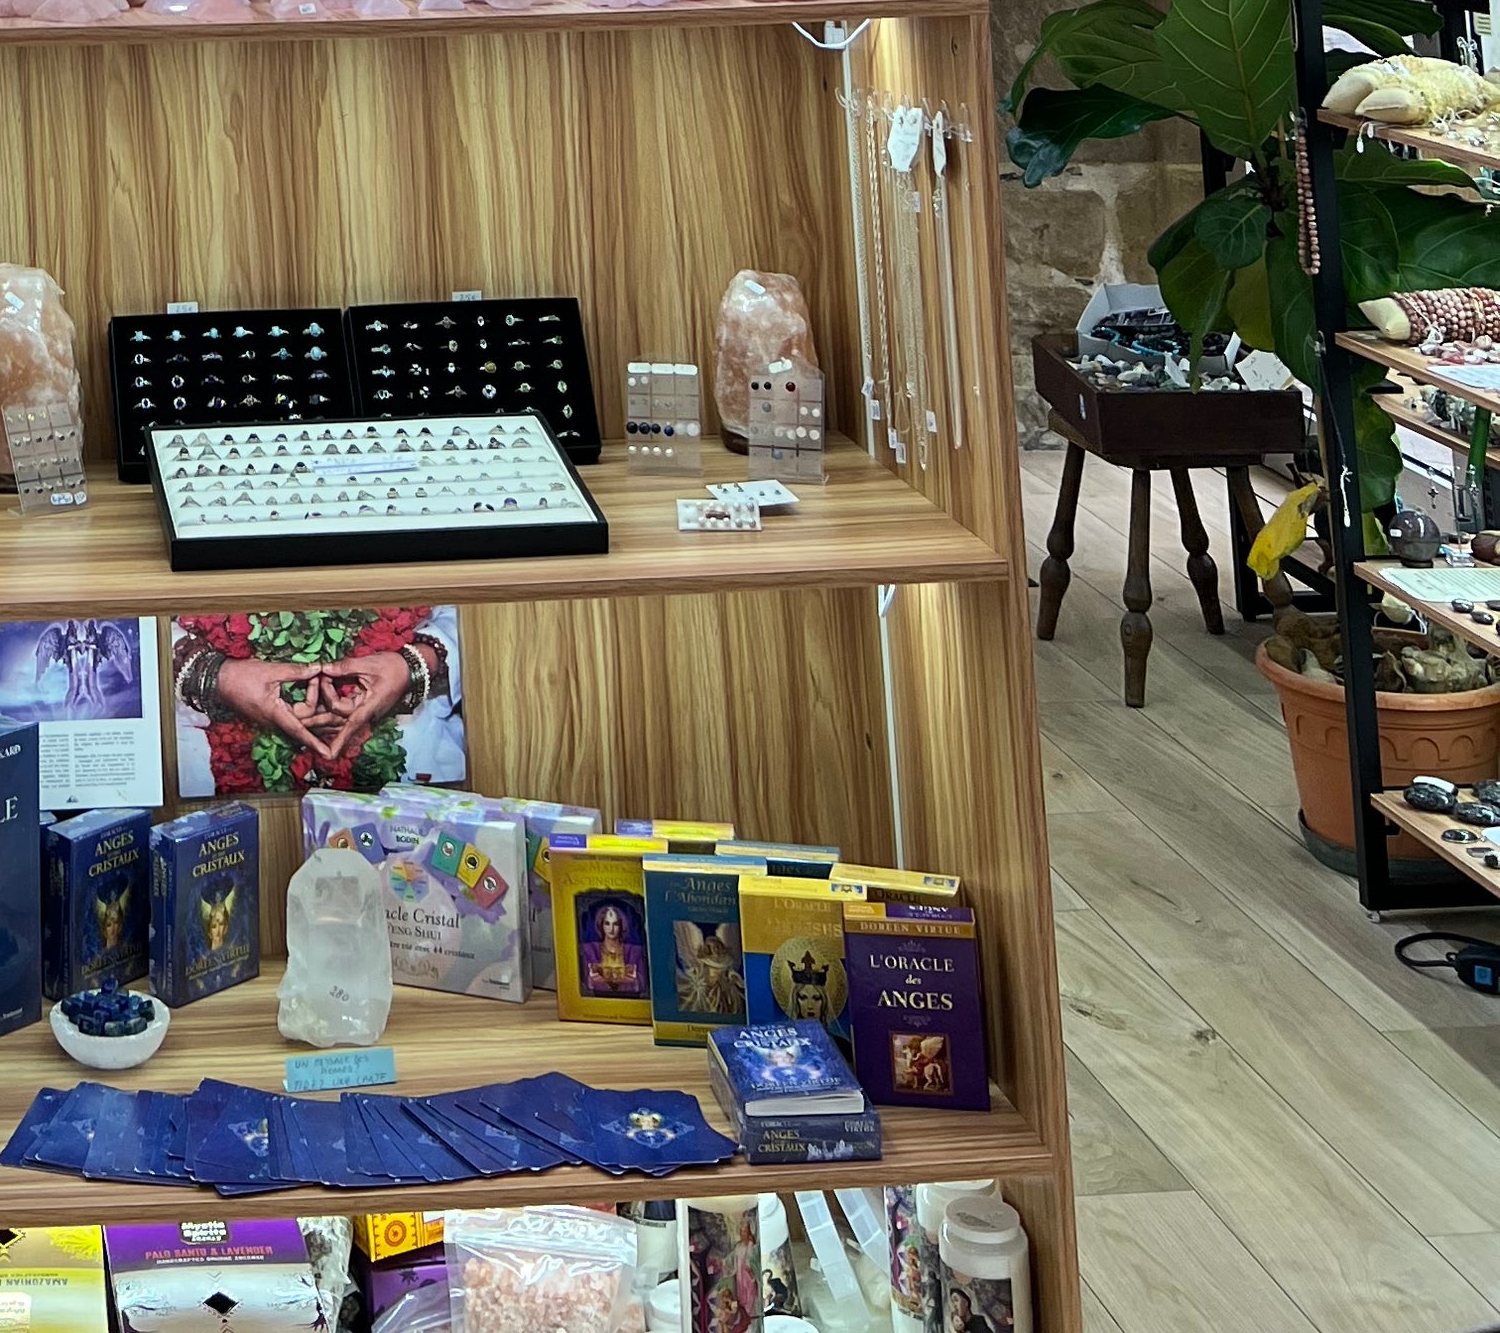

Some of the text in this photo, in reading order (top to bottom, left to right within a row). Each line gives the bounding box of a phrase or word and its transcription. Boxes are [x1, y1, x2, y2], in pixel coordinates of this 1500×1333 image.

[94, 829, 134, 857] ANGES
[198, 831, 239, 858] ANGES
[89, 846, 140, 877] CRISTAUX
[192, 849, 245, 878] CRISTAUX
[413, 908, 461, 930] Cristal
[414, 926, 442, 940] SHUI
[860, 921, 961, 934] DOREEN VIRTUE
[433, 946, 443, 954] 44
[870, 954, 955, 972] L'ORACLE
[905, 974, 922, 985] des
[877, 990, 954, 1011] ANGES
[739, 1027, 798, 1039] ANGES
[763, 1129, 800, 1140] ANGES
[757, 1143, 807, 1153] CRISTAUX
[145, 1250, 171, 1260] PALO
[174, 1248, 207, 1258] SANTO
[221, 1245, 273, 1256] LAVENDER
[6, 1277, 69, 1287] AMAZONIAN
